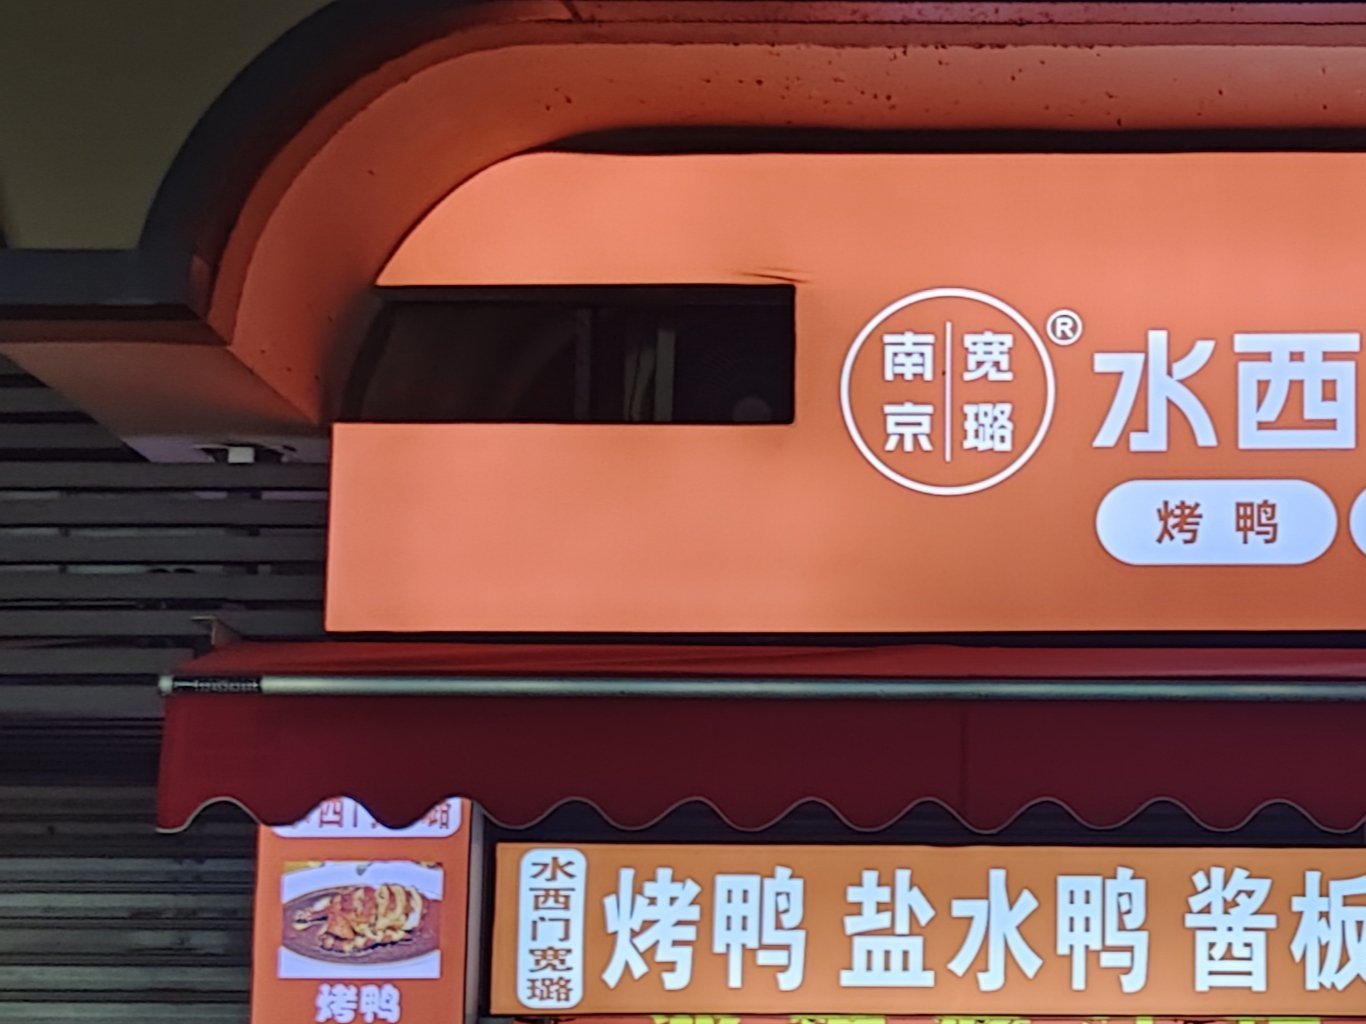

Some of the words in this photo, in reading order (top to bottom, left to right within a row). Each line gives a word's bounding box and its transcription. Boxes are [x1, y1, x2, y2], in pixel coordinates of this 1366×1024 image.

[882, 331, 935, 452] 南京
[962, 331, 1014, 452] 宽璐
[1155, 500, 1279, 545] 烤鸭
[526, 856, 576, 1003] 水西门宽璐
[602, 865, 807, 992] 烤鸭
[839, 866, 1151, 994] 盐水鸭
[314, 982, 401, 1024] 烤鸭
